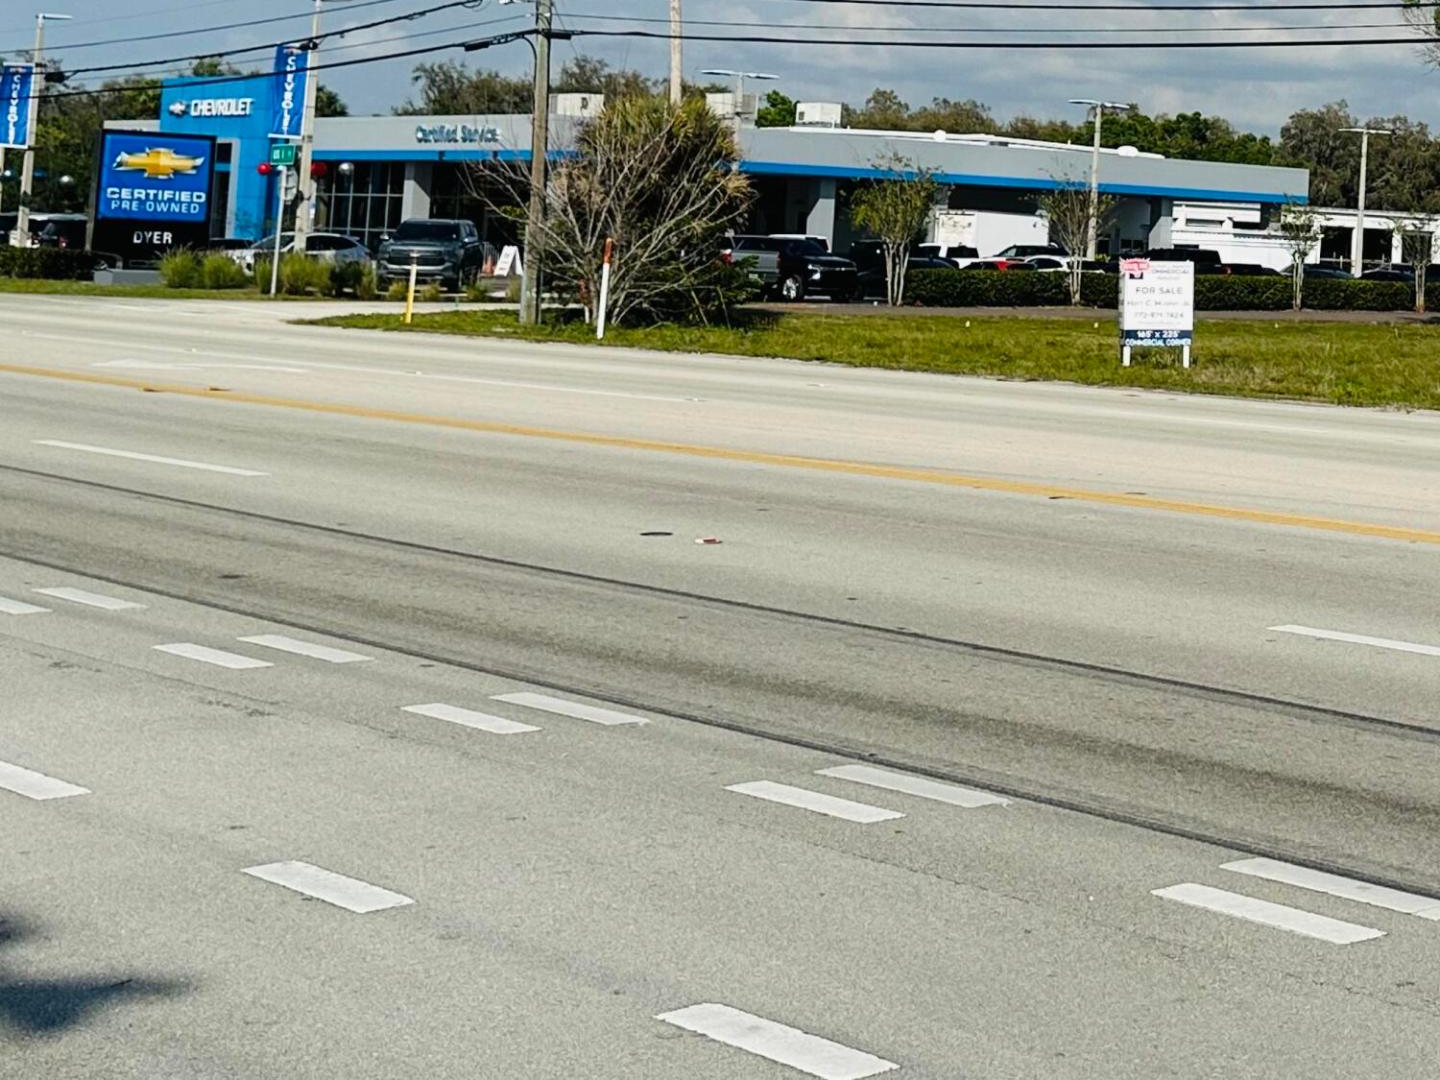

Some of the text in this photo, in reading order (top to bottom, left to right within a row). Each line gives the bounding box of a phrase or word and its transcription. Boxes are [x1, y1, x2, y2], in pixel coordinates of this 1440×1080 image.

[190, 97, 254, 117] CHEVROLET
[416, 124, 501, 143] Certified Service
[106, 187, 206, 203] CERTIFIED
[133, 231, 173, 244] DYER
[1135, 286, 1184, 295] FOR SALE
